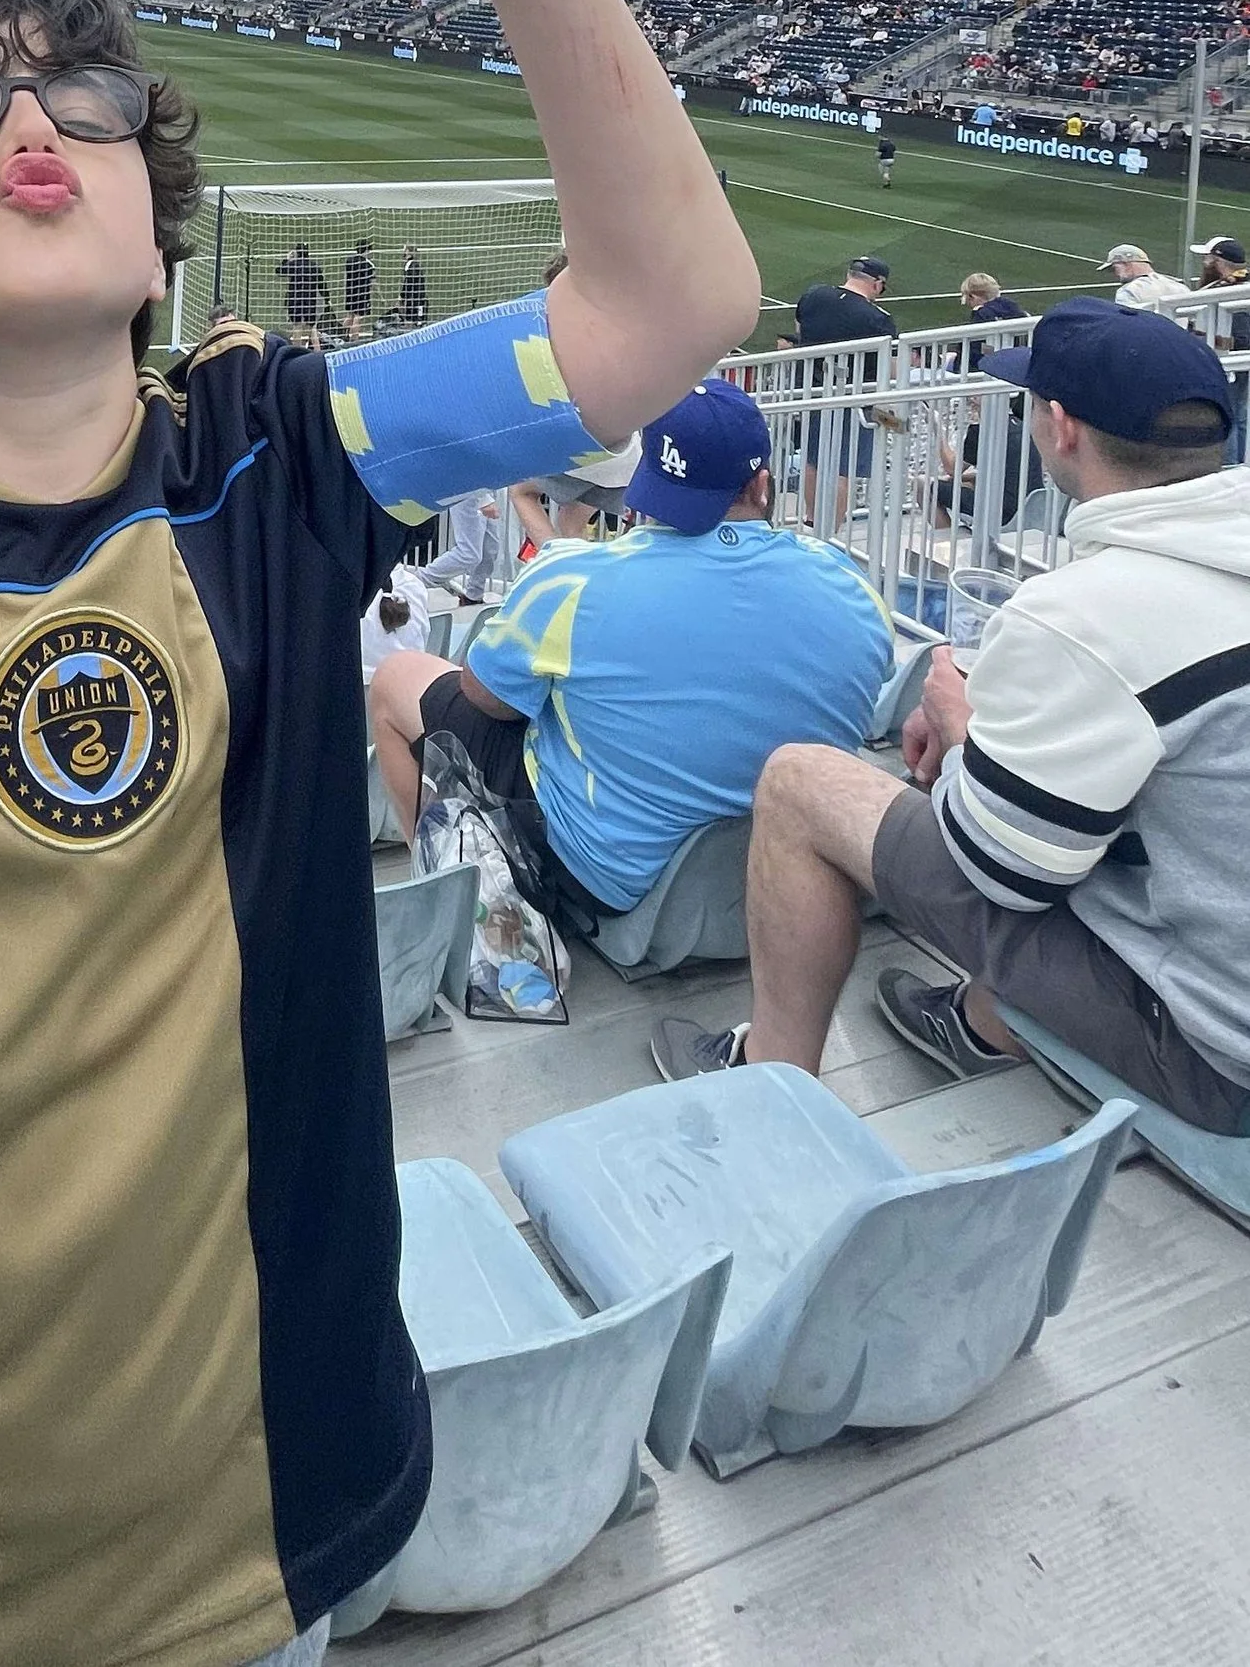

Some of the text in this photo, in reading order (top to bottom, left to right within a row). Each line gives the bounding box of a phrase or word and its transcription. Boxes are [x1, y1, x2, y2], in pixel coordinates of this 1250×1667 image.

[750, 98, 859, 127] ndependence
[956, 124, 1114, 166] Independence
[660, 435, 687, 478] LA
[49, 681, 118, 715] UNION
